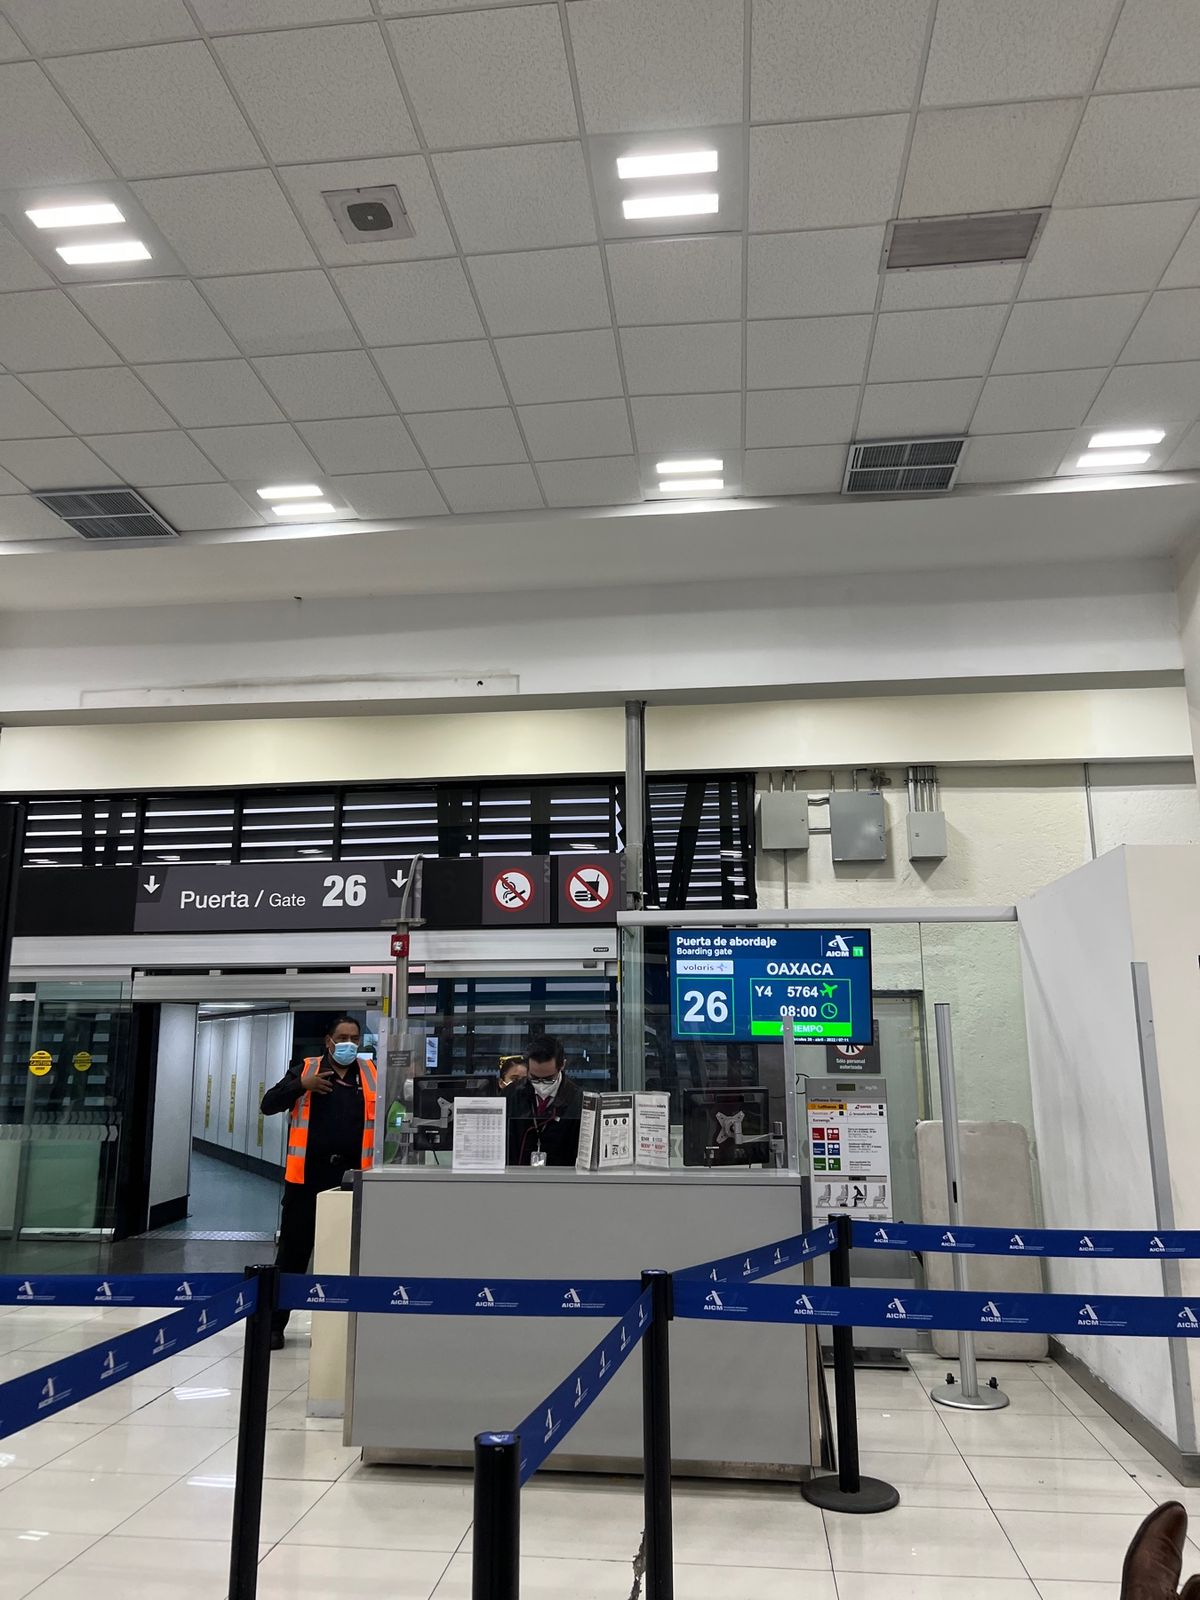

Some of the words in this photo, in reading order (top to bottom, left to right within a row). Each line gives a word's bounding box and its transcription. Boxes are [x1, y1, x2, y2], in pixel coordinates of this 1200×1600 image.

[180, 890, 249, 909] Puerta
[254, 890, 264, 908] /
[269, 893, 306, 907] Gate
[322, 874, 367, 907] 26
[676, 936, 711, 946] Puerta
[713, 936, 727, 946] de
[729, 936, 777, 948] abordaje
[676, 948, 713, 956] Boarding
[714, 948, 733, 956] gate
[683, 963, 714, 971] volaris
[766, 963, 834, 976] OAXACA
[755, 986, 773, 998] Y4
[787, 986, 819, 998] 5764
[683, 990, 729, 1023] 26
[779, 1005, 817, 1018] 08:00
